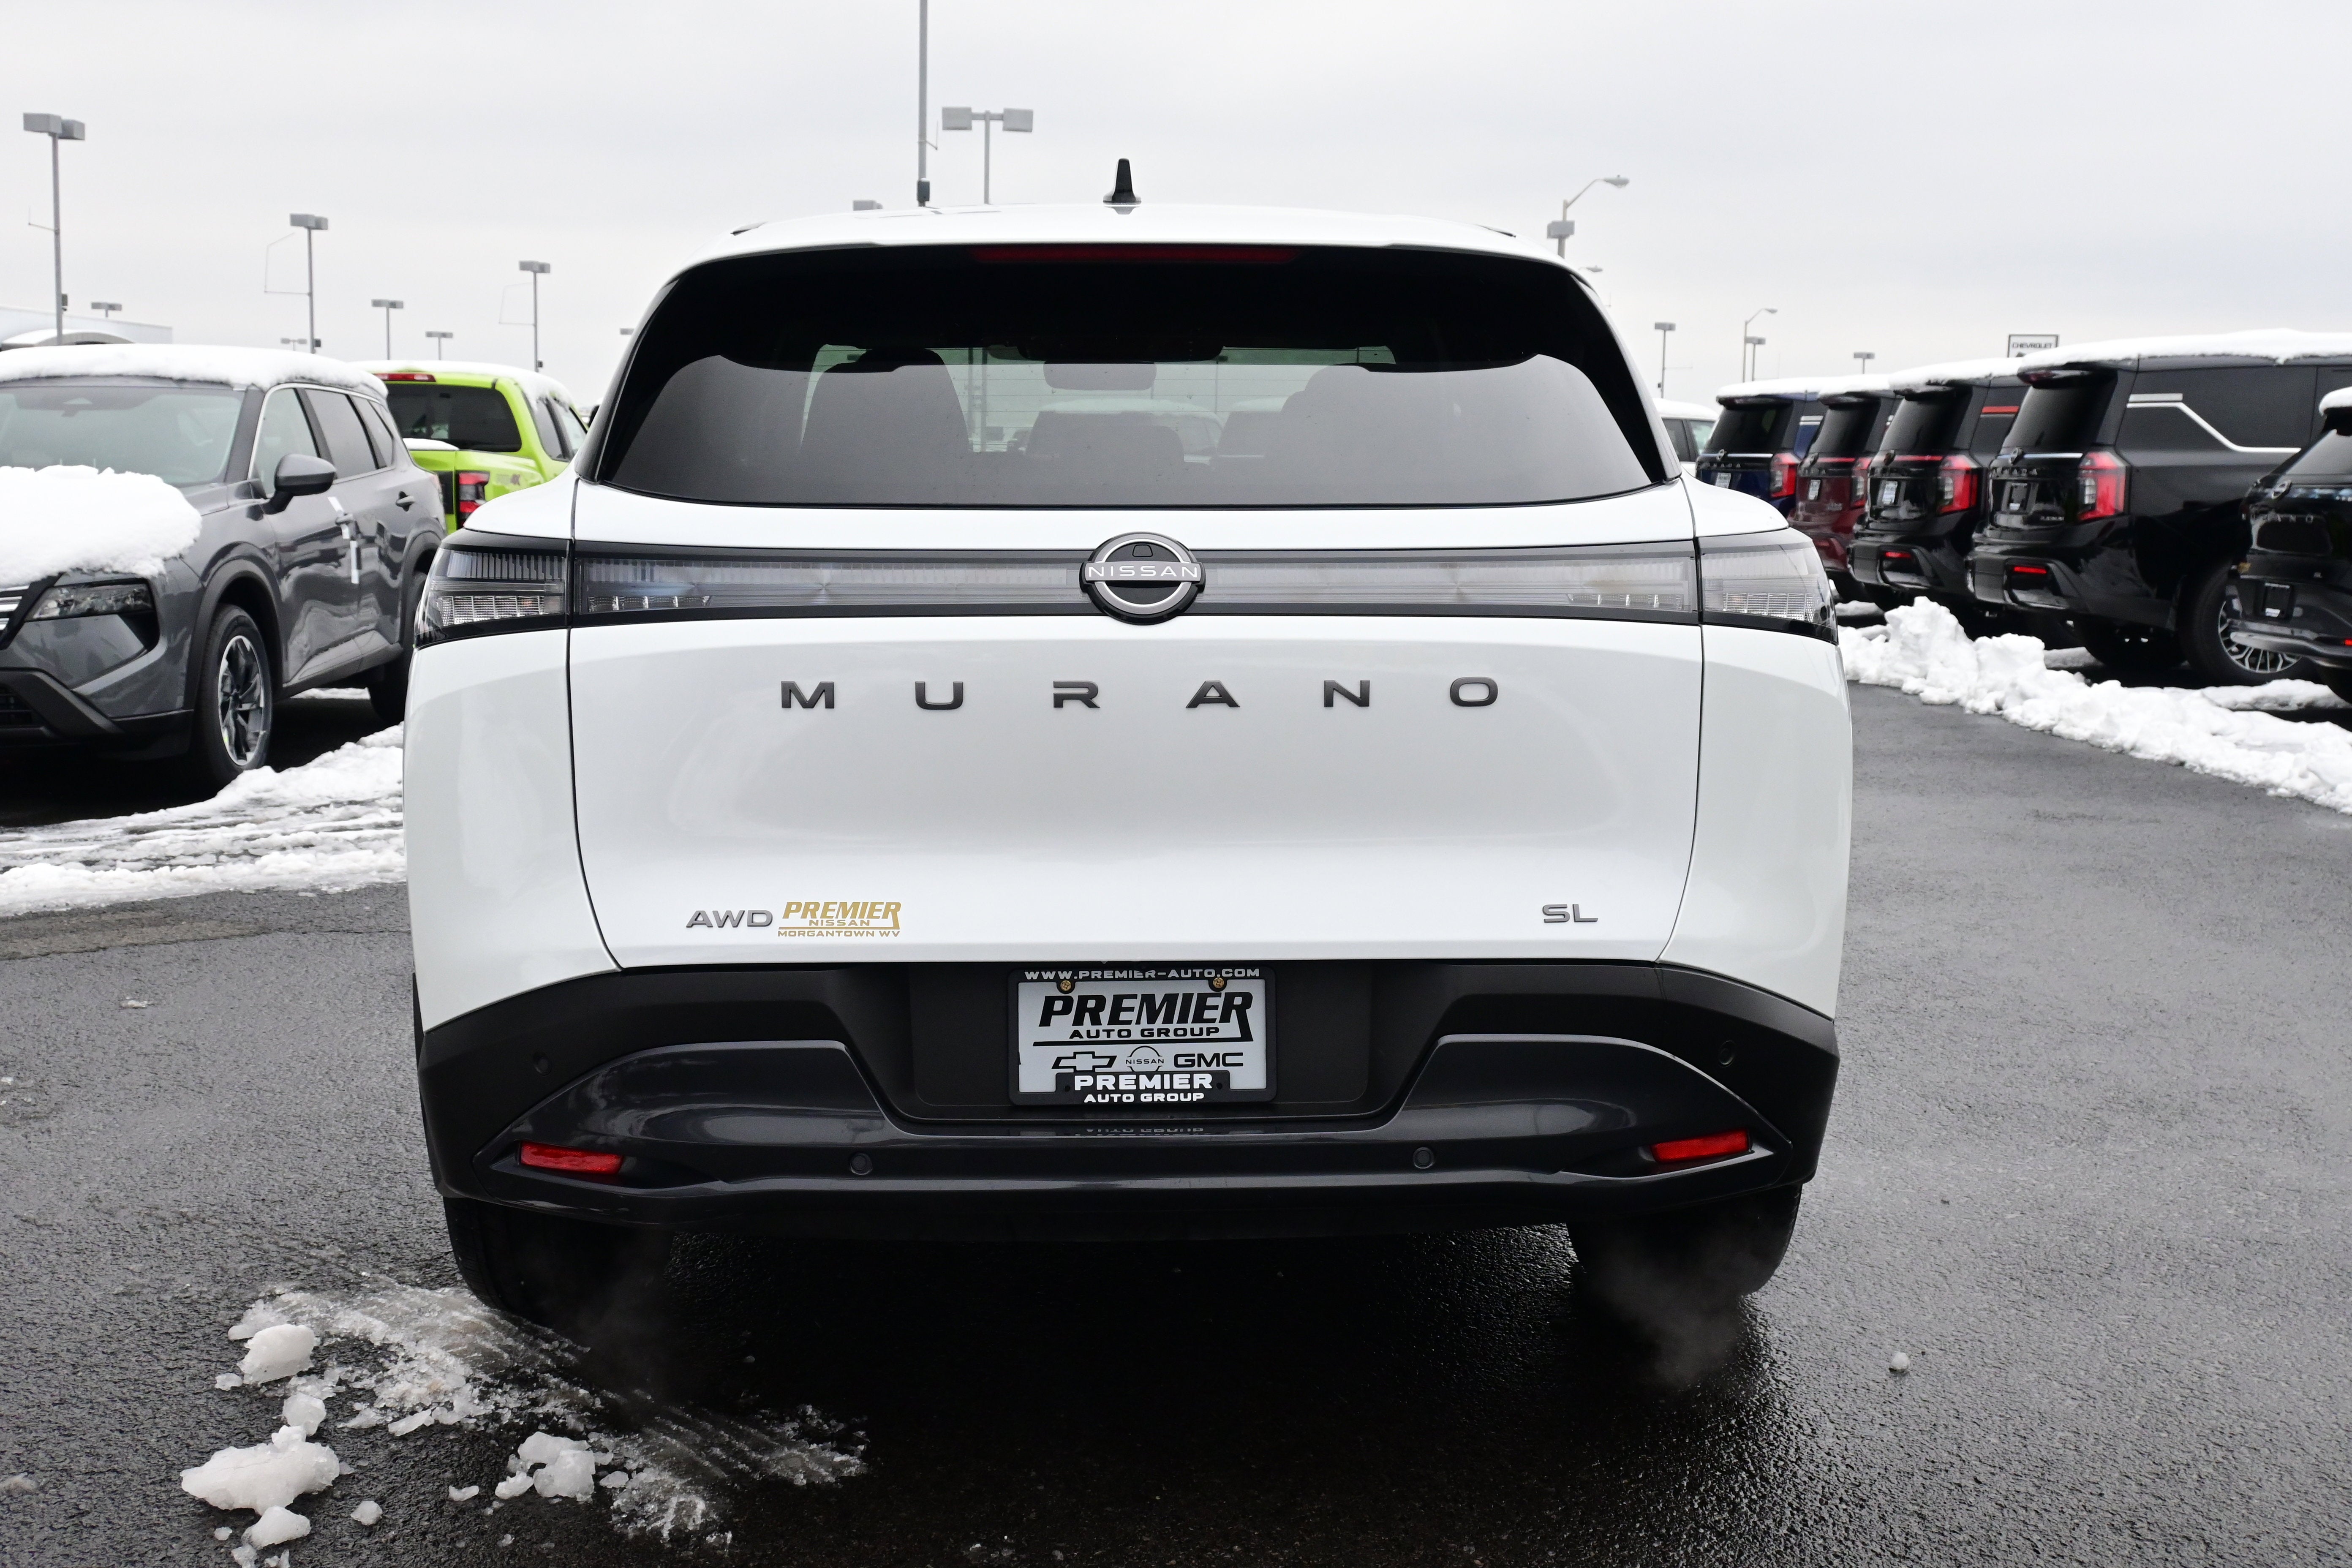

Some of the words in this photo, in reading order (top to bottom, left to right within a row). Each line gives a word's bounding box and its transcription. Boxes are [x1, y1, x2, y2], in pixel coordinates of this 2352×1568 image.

[1088, 565, 1198, 578] NISSAN
[781, 677, 1498, 710] MURANO
[686, 910, 773, 928] AWD
[782, 901, 901, 929] PREMIER
[1542, 904, 1598, 923] SL
[1025, 968, 1260, 980] WWW.PREMIER-AUTO.COM
[1038, 992, 1253, 1041] PREMIER
[1069, 1029, 1132, 1039] AUTO
[1140, 1027, 1220, 1037] GROUP
[1173, 1052, 1244, 1068] GMC
[1074, 1073, 1212, 1091] PREMIER
[1084, 1094, 1134, 1103] AUTO
[1140, 1092, 1204, 1102] GROUP
